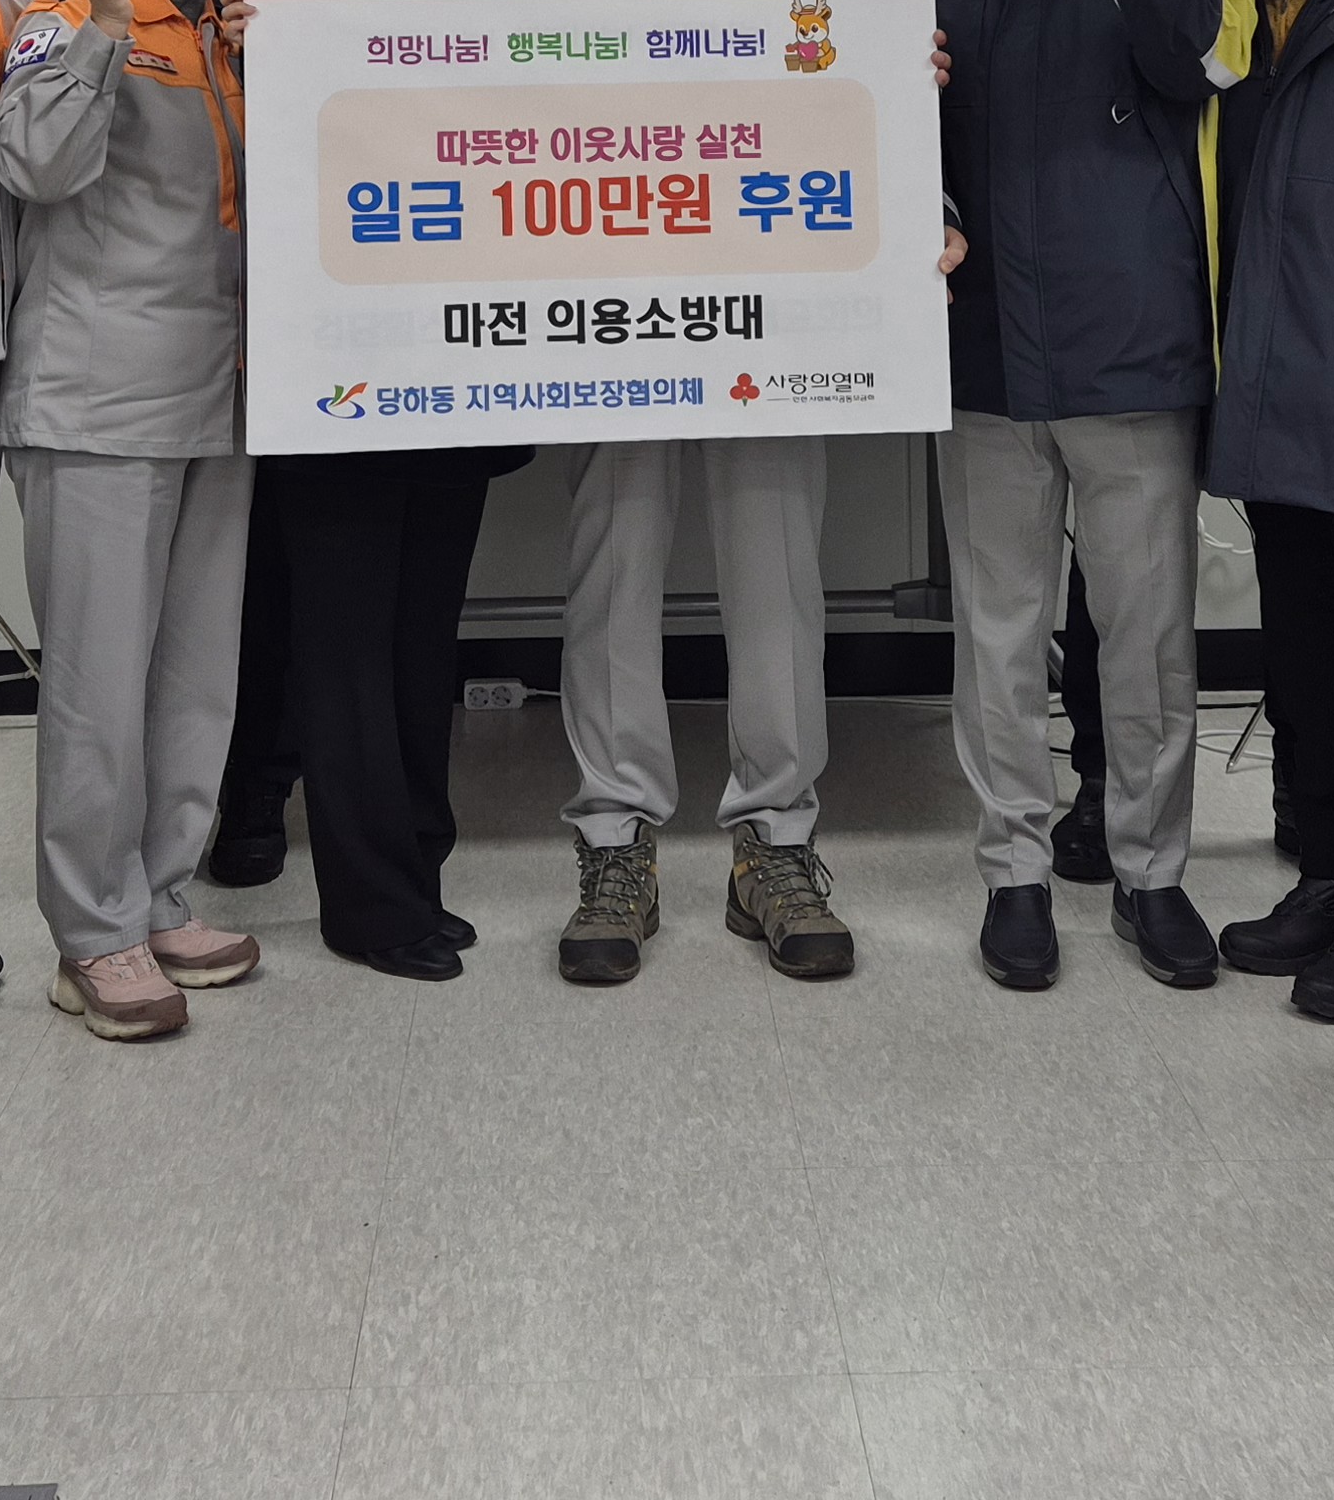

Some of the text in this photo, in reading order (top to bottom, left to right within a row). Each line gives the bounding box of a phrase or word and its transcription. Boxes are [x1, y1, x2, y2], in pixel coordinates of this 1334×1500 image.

[366, 28, 766, 66] 희망나눔! 행복나눔! 함께나눔!
[436, 122, 763, 167] 따뜻한 이웃사랑 실천
[346, 169, 854, 244] 일금 100만원 후원
[443, 300, 528, 349] 마전
[546, 293, 764, 346] 의용소방대
[376, 376, 704, 417] 당하동 지역사회보장협의체
[765, 372, 875, 395] 사랑의열매
